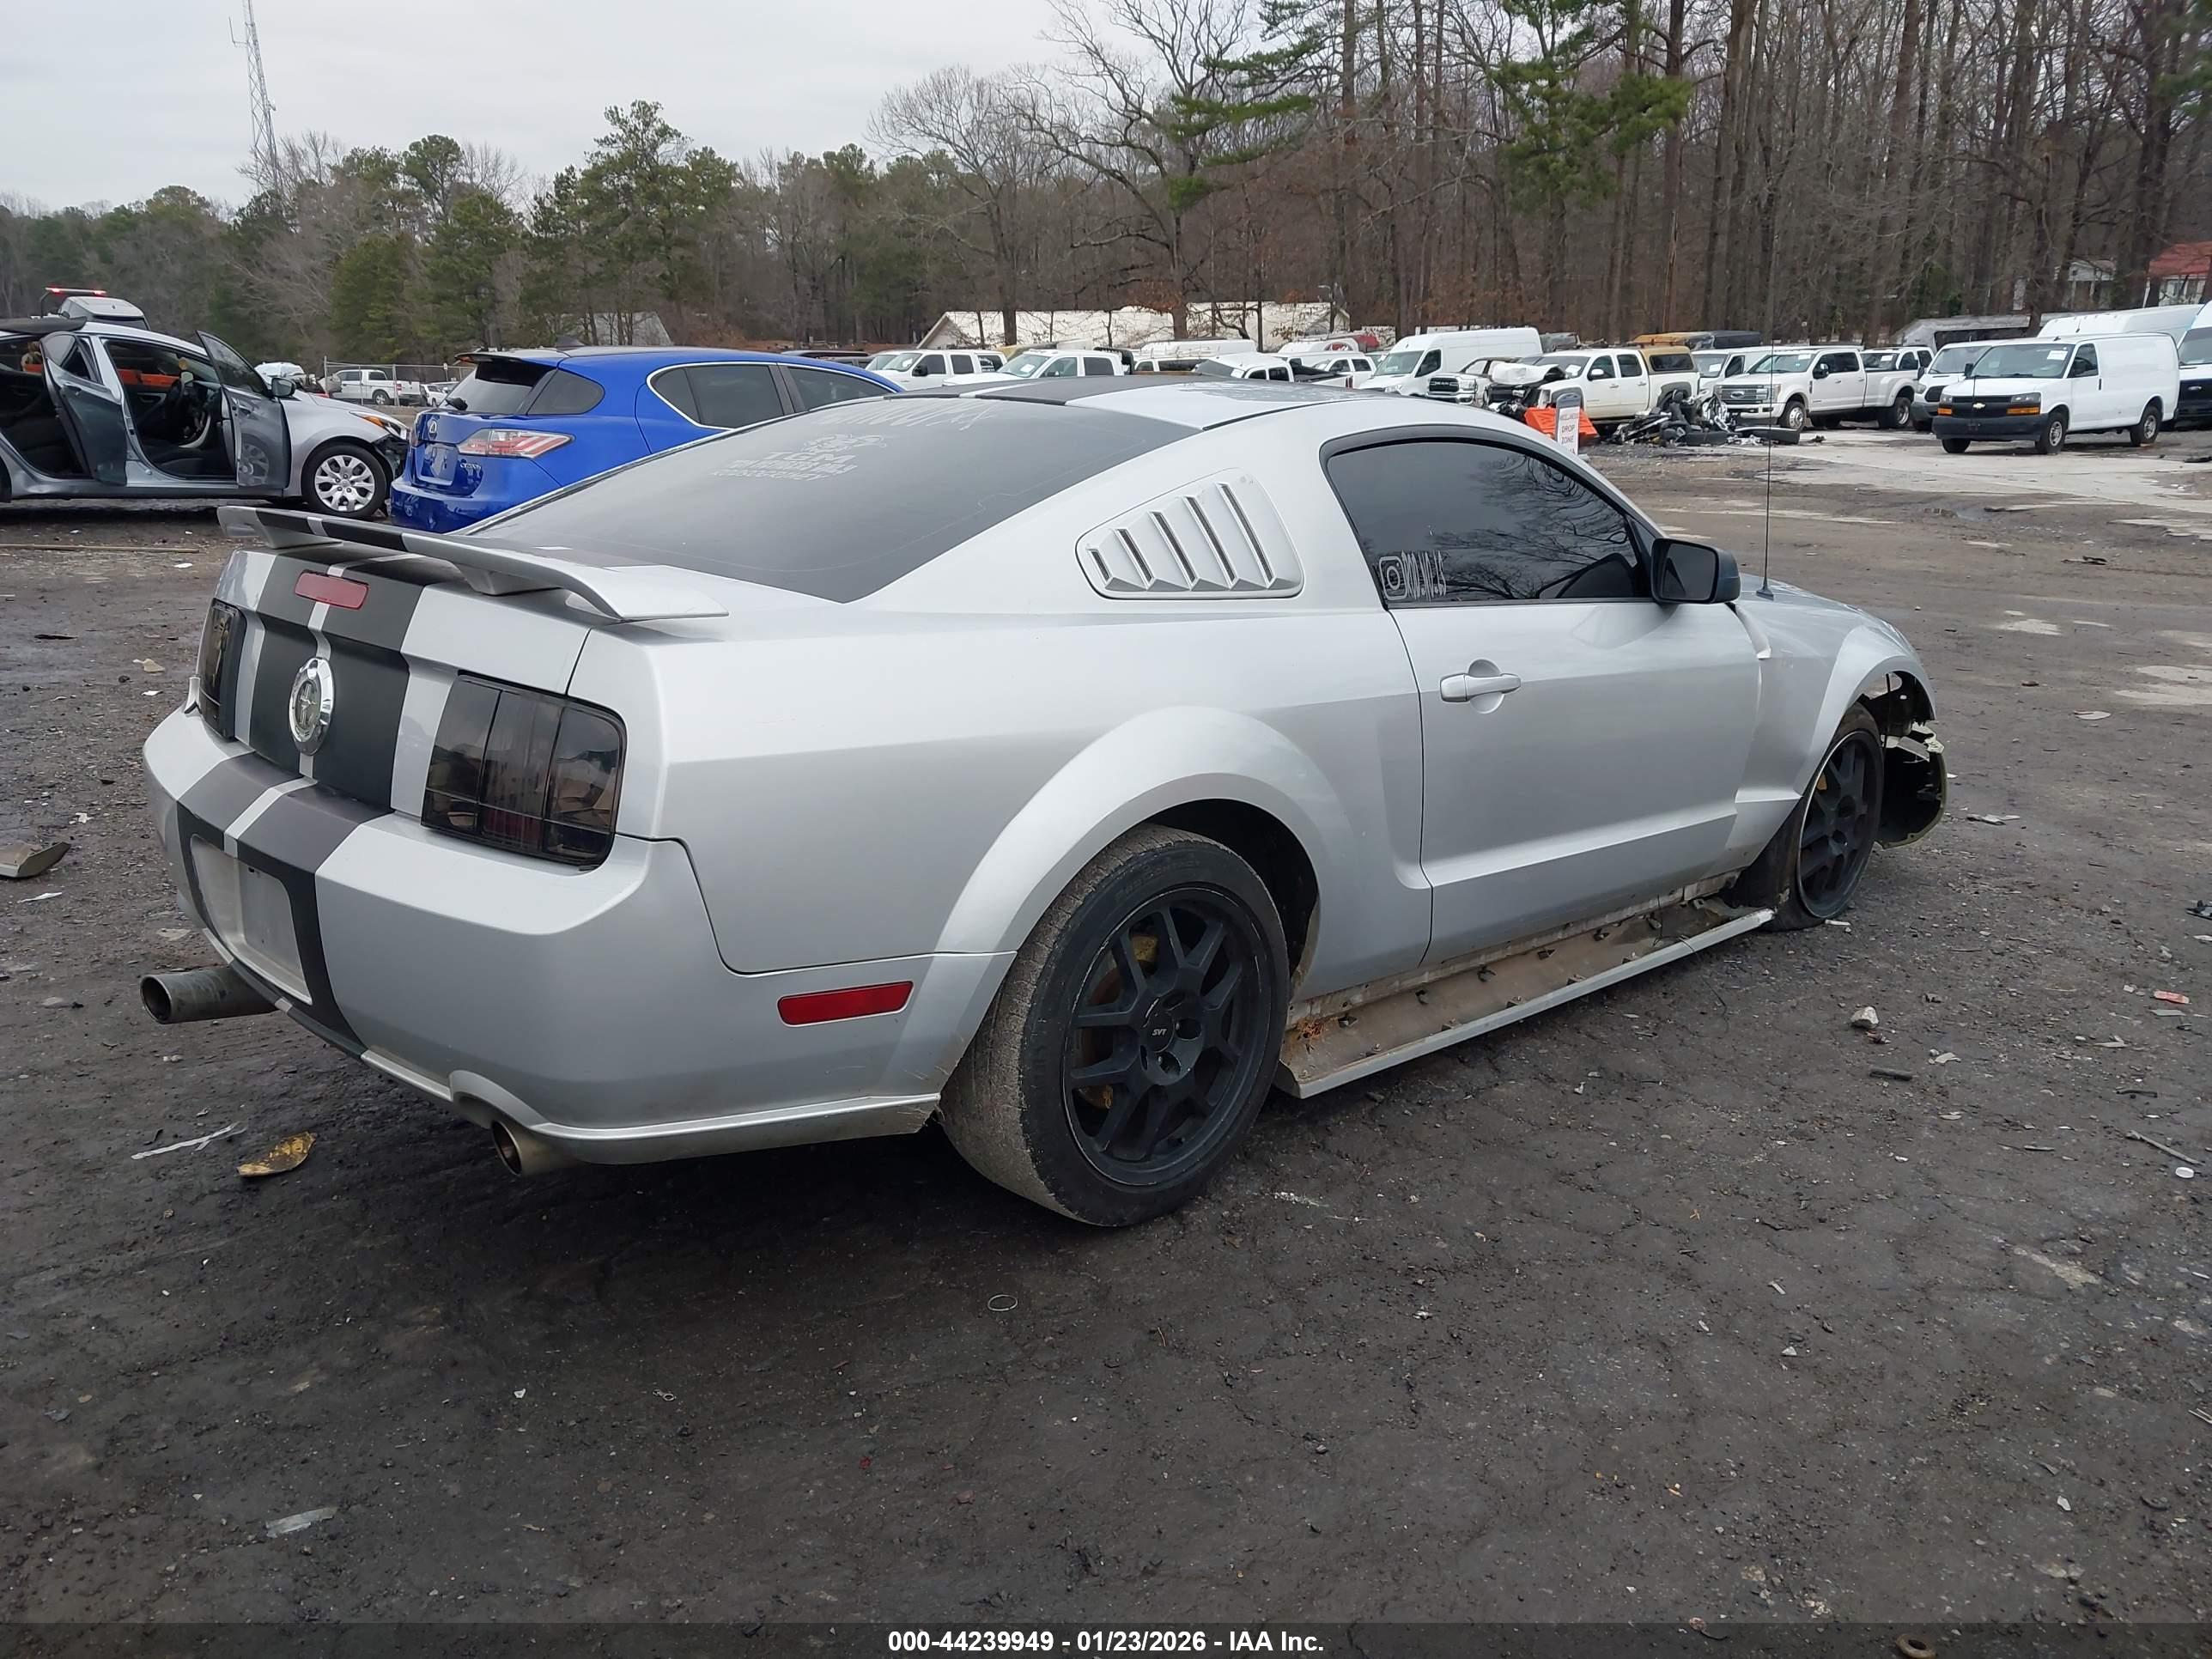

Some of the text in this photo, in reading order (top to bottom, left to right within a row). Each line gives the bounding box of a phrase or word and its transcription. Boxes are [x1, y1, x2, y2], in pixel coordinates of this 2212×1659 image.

[1561, 424, 1576, 433] DROP
[1561, 435, 1574, 445] ZONE
[763, 452, 857, 465] TGM
[1152, 1028, 1168, 1036] SVT
